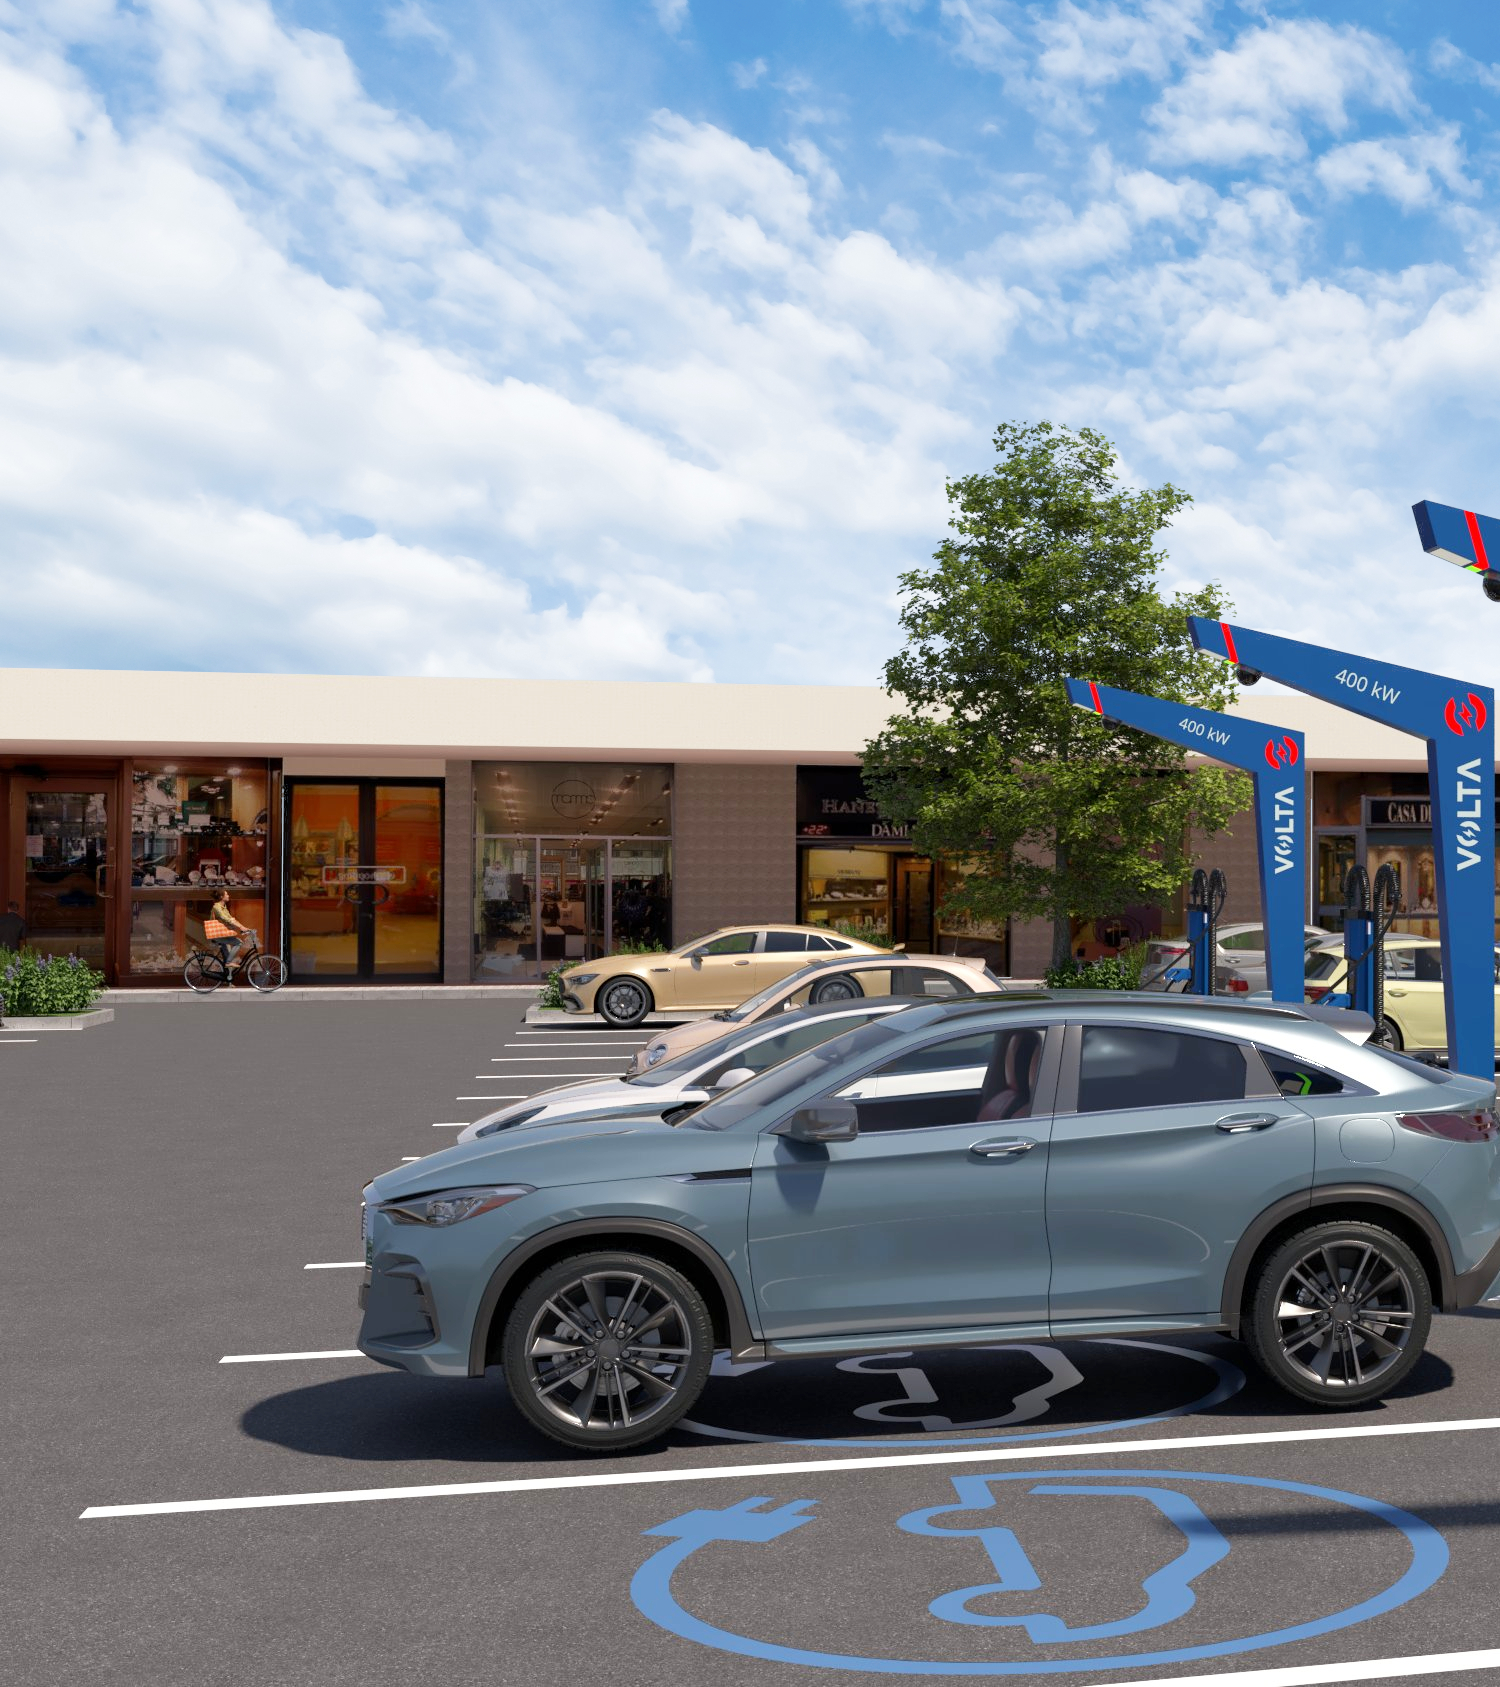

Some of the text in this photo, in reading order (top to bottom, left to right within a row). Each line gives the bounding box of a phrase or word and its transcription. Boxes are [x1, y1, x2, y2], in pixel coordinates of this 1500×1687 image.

[1335, 669, 1401, 705] 400 kW
[1178, 718, 1231, 746] 400 kW
[1388, 801, 1417, 823] CASA
[1456, 758, 1482, 871] VOLTA
[1274, 786, 1295, 875] VOLTA
